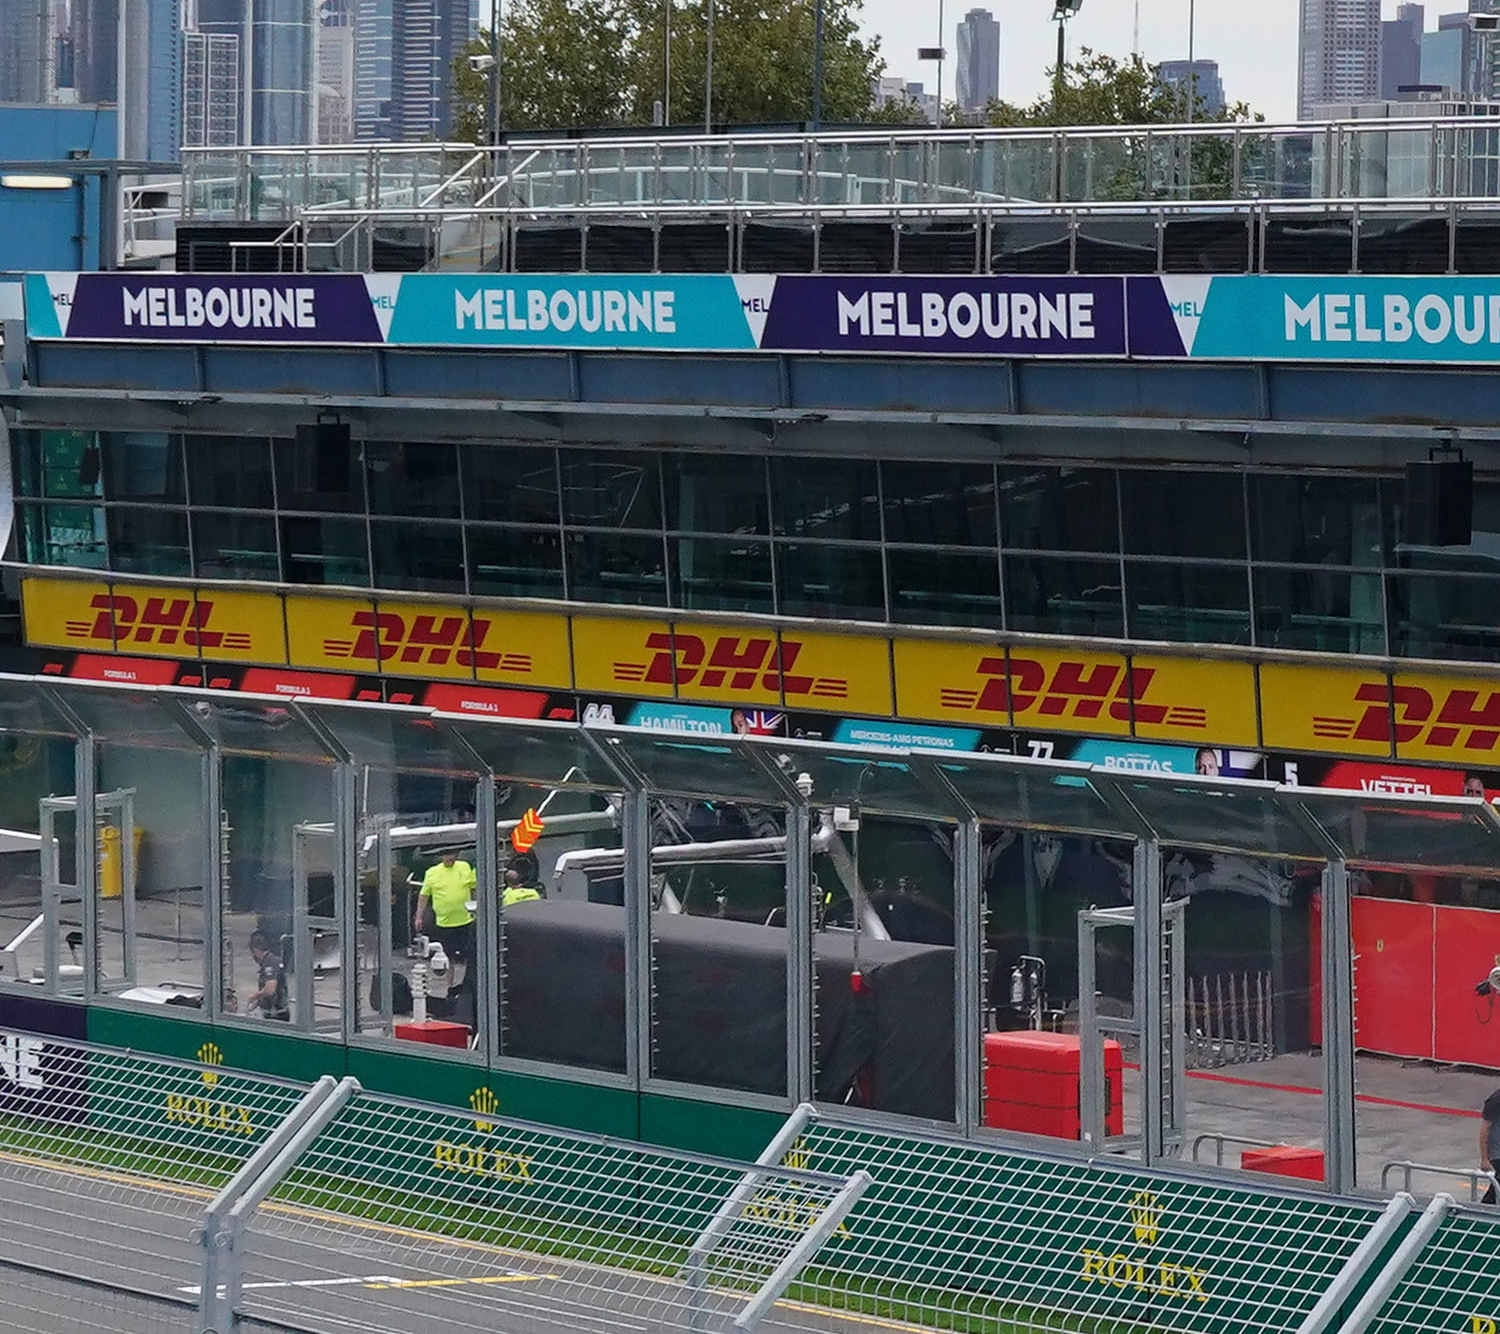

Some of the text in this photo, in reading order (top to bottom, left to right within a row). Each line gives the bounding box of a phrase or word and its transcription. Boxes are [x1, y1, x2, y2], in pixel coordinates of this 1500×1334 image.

[123, 287, 315, 327] MELBOURNE
[455, 289, 676, 332] MELBOURNE
[838, 291, 1094, 339] MELBOURNE
[91, 595, 225, 648] DHL
[351, 611, 502, 669] DHL
[645, 632, 814, 695] DHL
[974, 656, 1170, 724] DHL
[583, 703, 615, 724] 44
[640, 716, 722, 734] HAMILTON
[1028, 740, 1054, 760] 77
[1104, 755, 1173, 773] BOTTAS
[1284, 762, 1298, 786] 5
[166, 1094, 253, 1134] ROLEX
[435, 1141, 535, 1185] ROLEX
[1081, 1248, 1208, 1301] ROLEX
